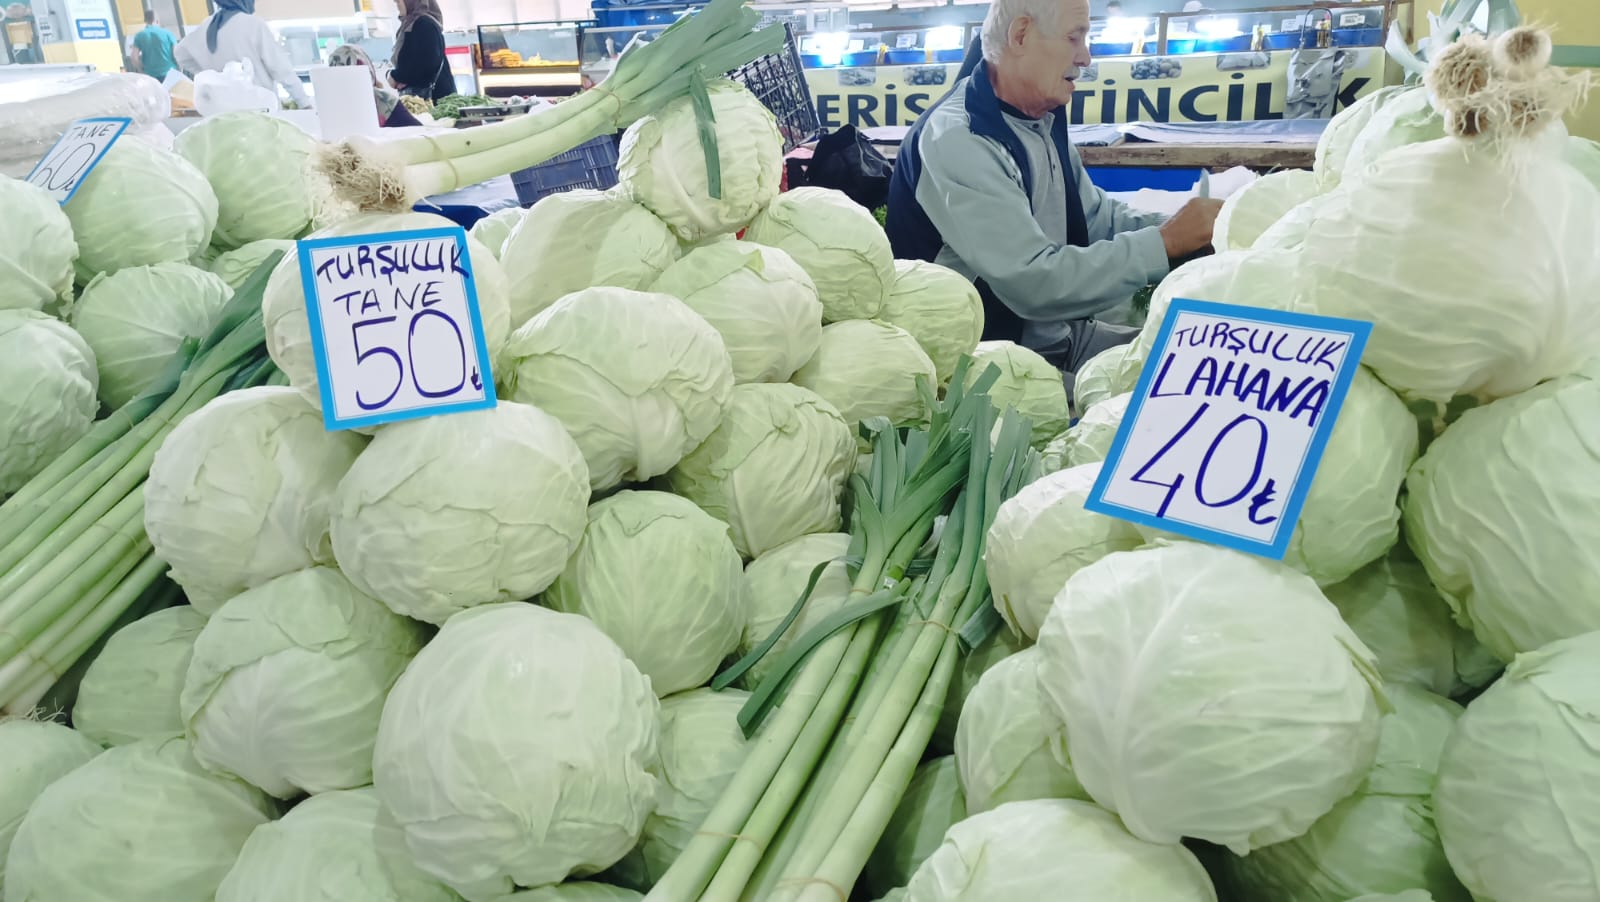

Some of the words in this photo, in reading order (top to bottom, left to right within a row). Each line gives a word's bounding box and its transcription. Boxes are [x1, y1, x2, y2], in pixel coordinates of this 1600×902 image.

[333, 281, 446, 316] TANE
[1175, 322, 1346, 372] TURŞULUK
[1149, 352, 1331, 428] LAHANA
